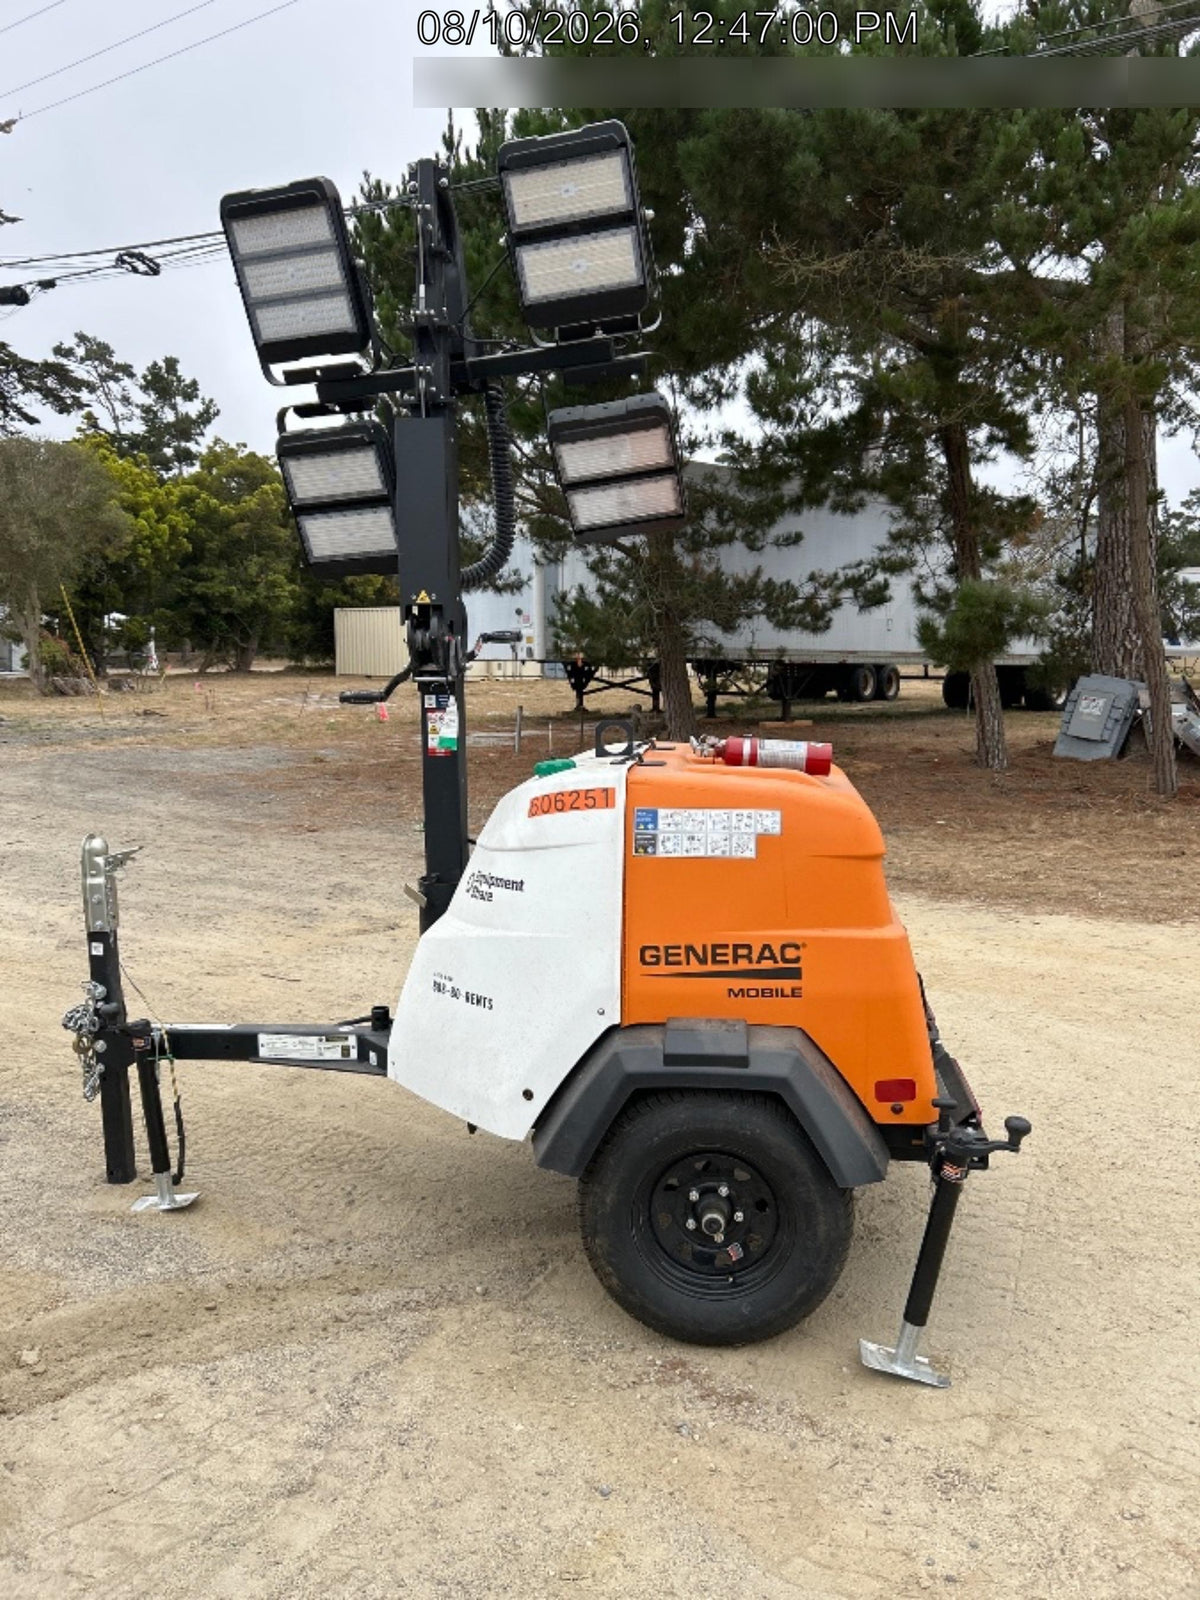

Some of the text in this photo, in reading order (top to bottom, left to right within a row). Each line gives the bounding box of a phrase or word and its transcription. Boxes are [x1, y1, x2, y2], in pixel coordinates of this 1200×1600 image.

[530, 788, 609, 817] 606251
[639, 943, 802, 966] GENERAC
[727, 987, 803, 998] MOBILE
